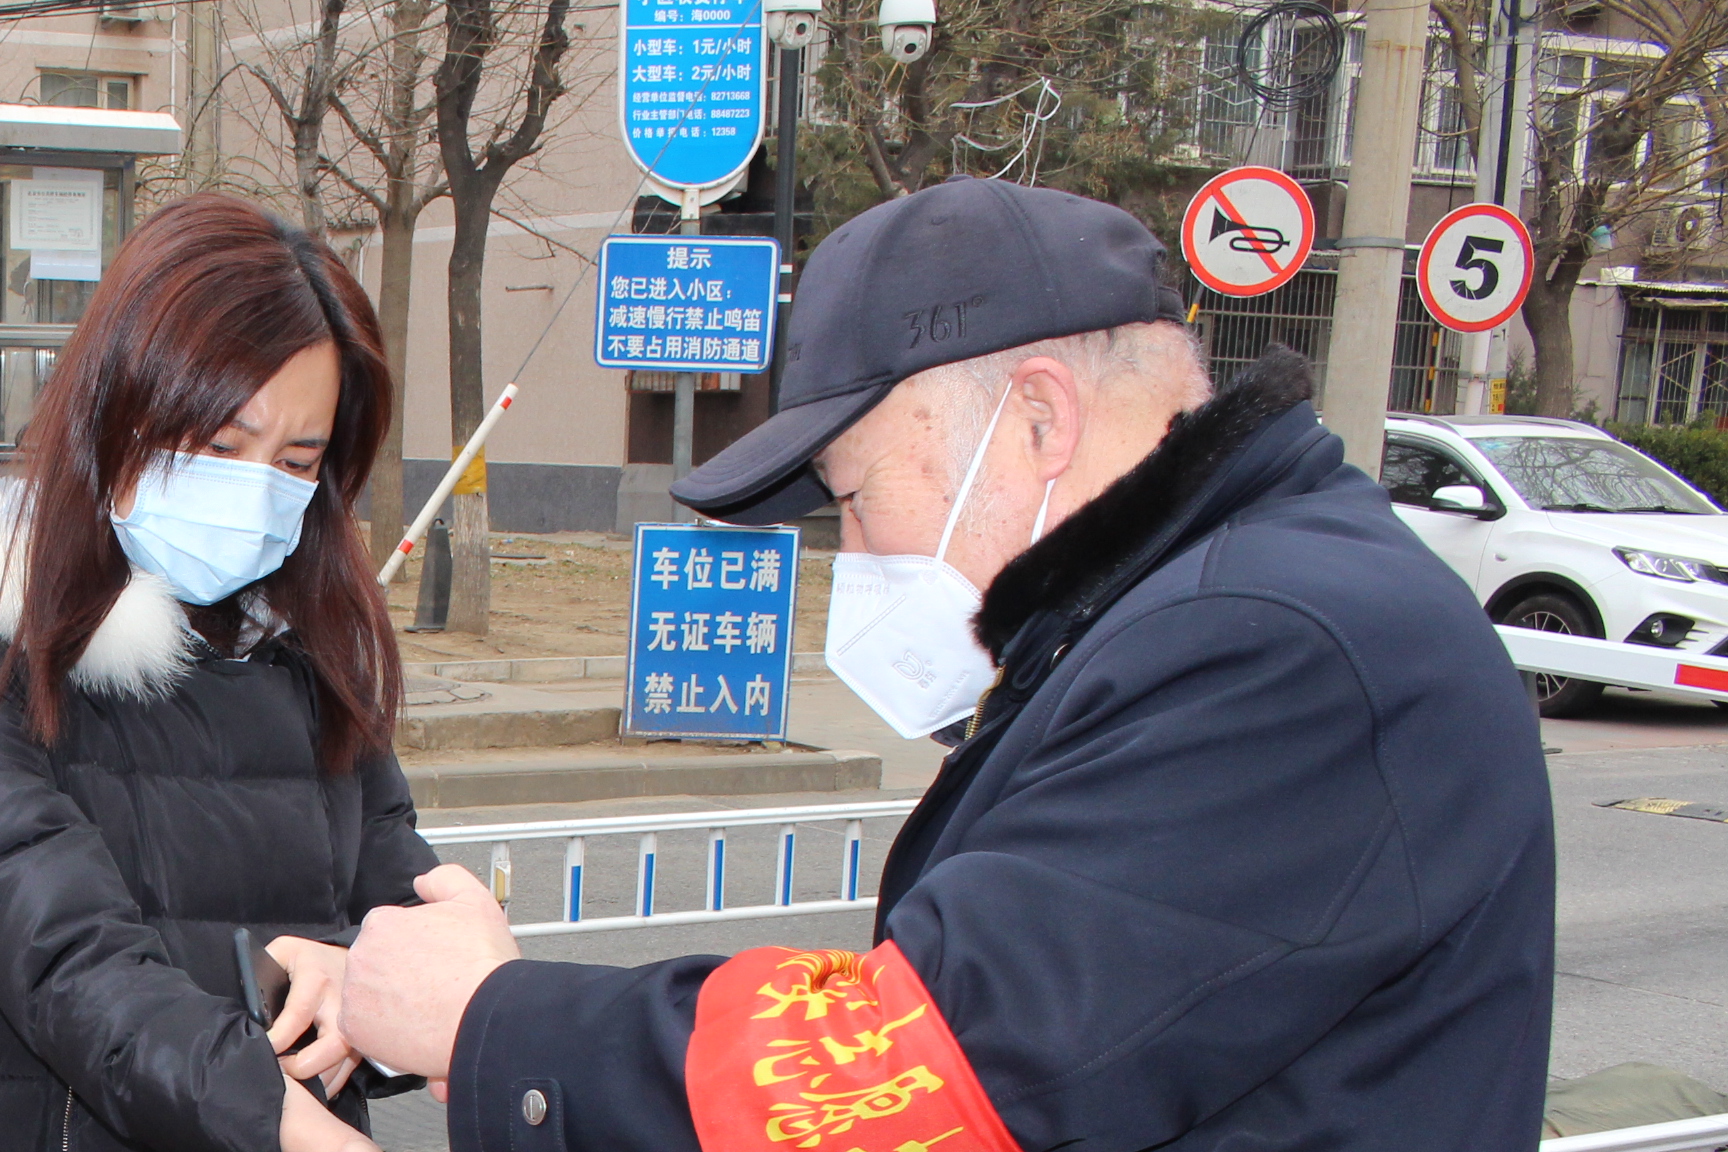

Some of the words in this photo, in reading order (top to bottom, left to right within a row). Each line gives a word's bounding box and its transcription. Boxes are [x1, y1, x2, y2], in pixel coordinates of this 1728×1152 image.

[633, 37, 752, 56] 小型车：1元/小时
[632, 64, 752, 82] 大型车：2元/小时
[667, 246, 712, 270] 提示
[1448, 235, 1506, 301] 5
[608, 306, 762, 333] 减速慢行禁止鸣笛
[607, 334, 761, 361] 不要占用消防通道
[650, 546, 781, 592] 车位已满
[646, 610, 779, 655] 无证车辆
[643, 672, 771, 717] 禁止入内
